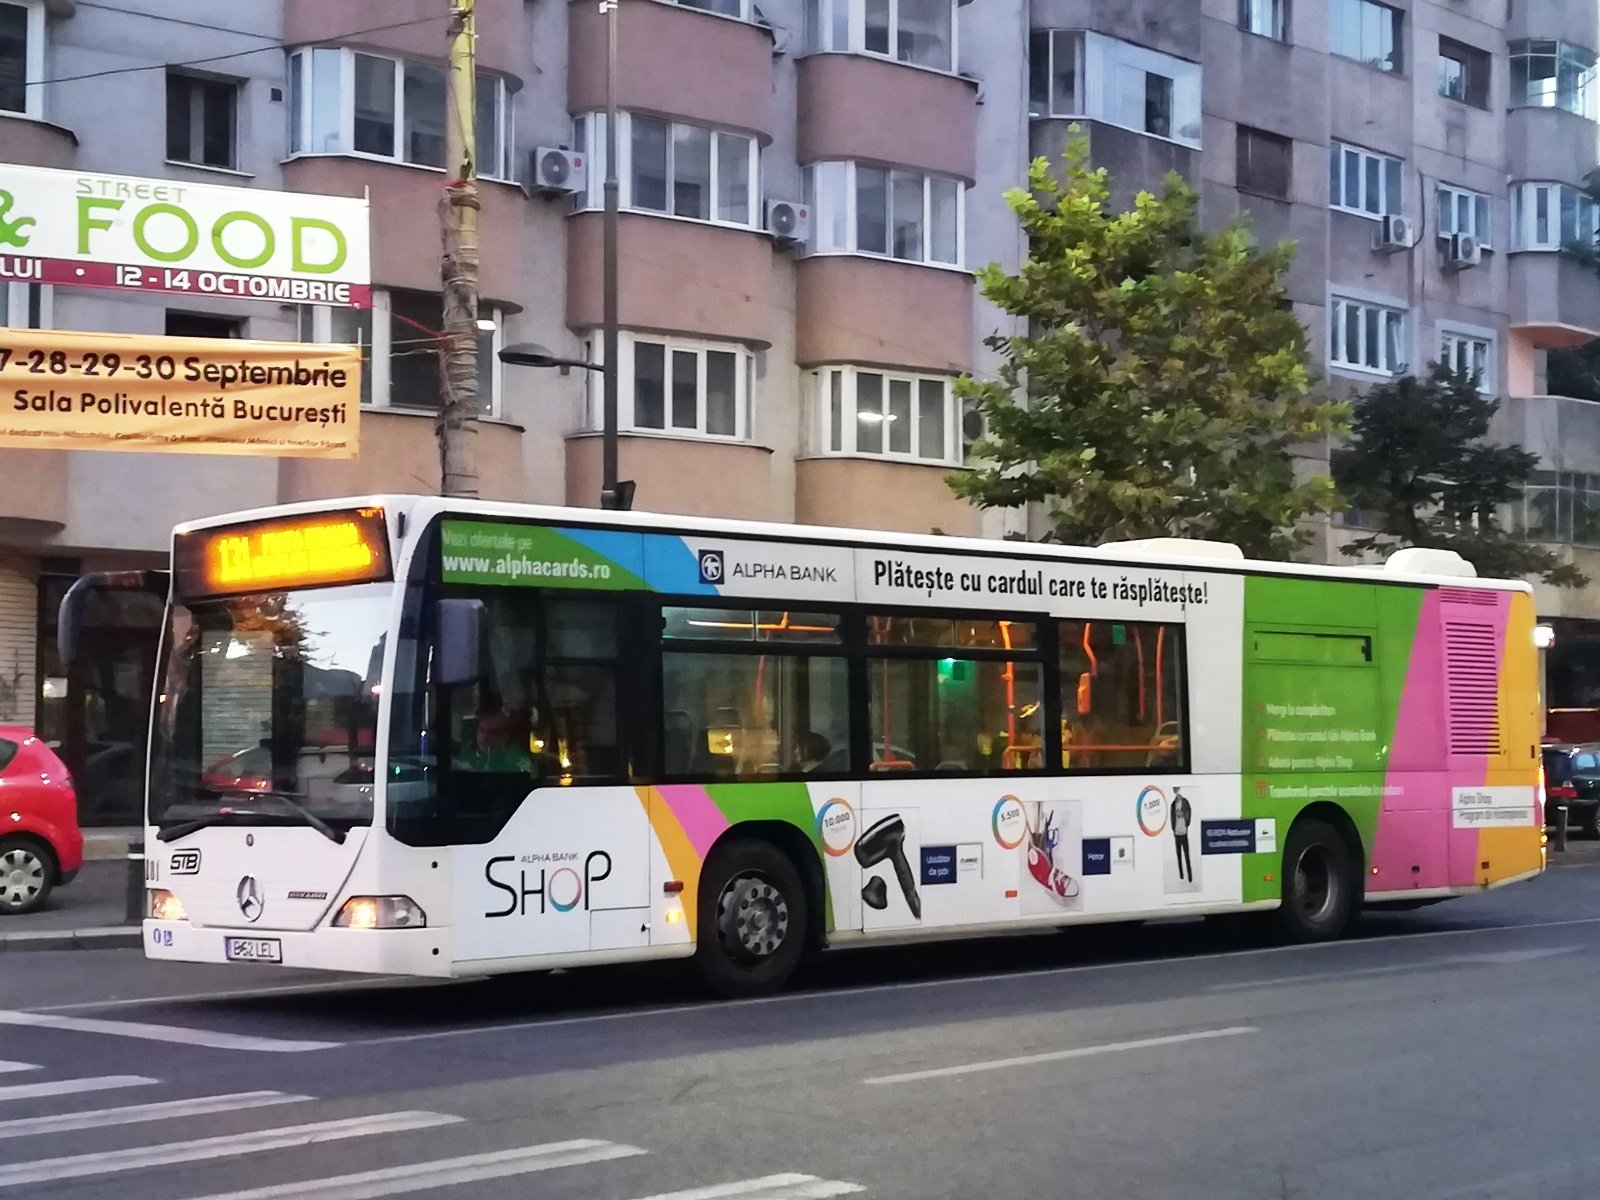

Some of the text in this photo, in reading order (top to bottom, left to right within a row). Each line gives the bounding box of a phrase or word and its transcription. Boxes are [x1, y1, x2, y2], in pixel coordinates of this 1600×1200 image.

[76, 178, 187, 203] STREET
[76, 196, 348, 274] FOOD
[116, 265, 142, 286] 12
[164, 270, 191, 290] 14
[198, 272, 350, 302] OCTOMBRIE
[184, 357, 346, 389] Septembrie
[14, 389, 346, 428] Sala Polivalentă București
[443, 553, 611, 580] www.alphacards.ro
[733, 563, 837, 582] ALPHA BANK
[874, 560, 1208, 611] Plătește cu cardul care te răsplătește!
[170, 853, 198, 870] STB
[521, 852, 578, 863] ALPHA BANK
